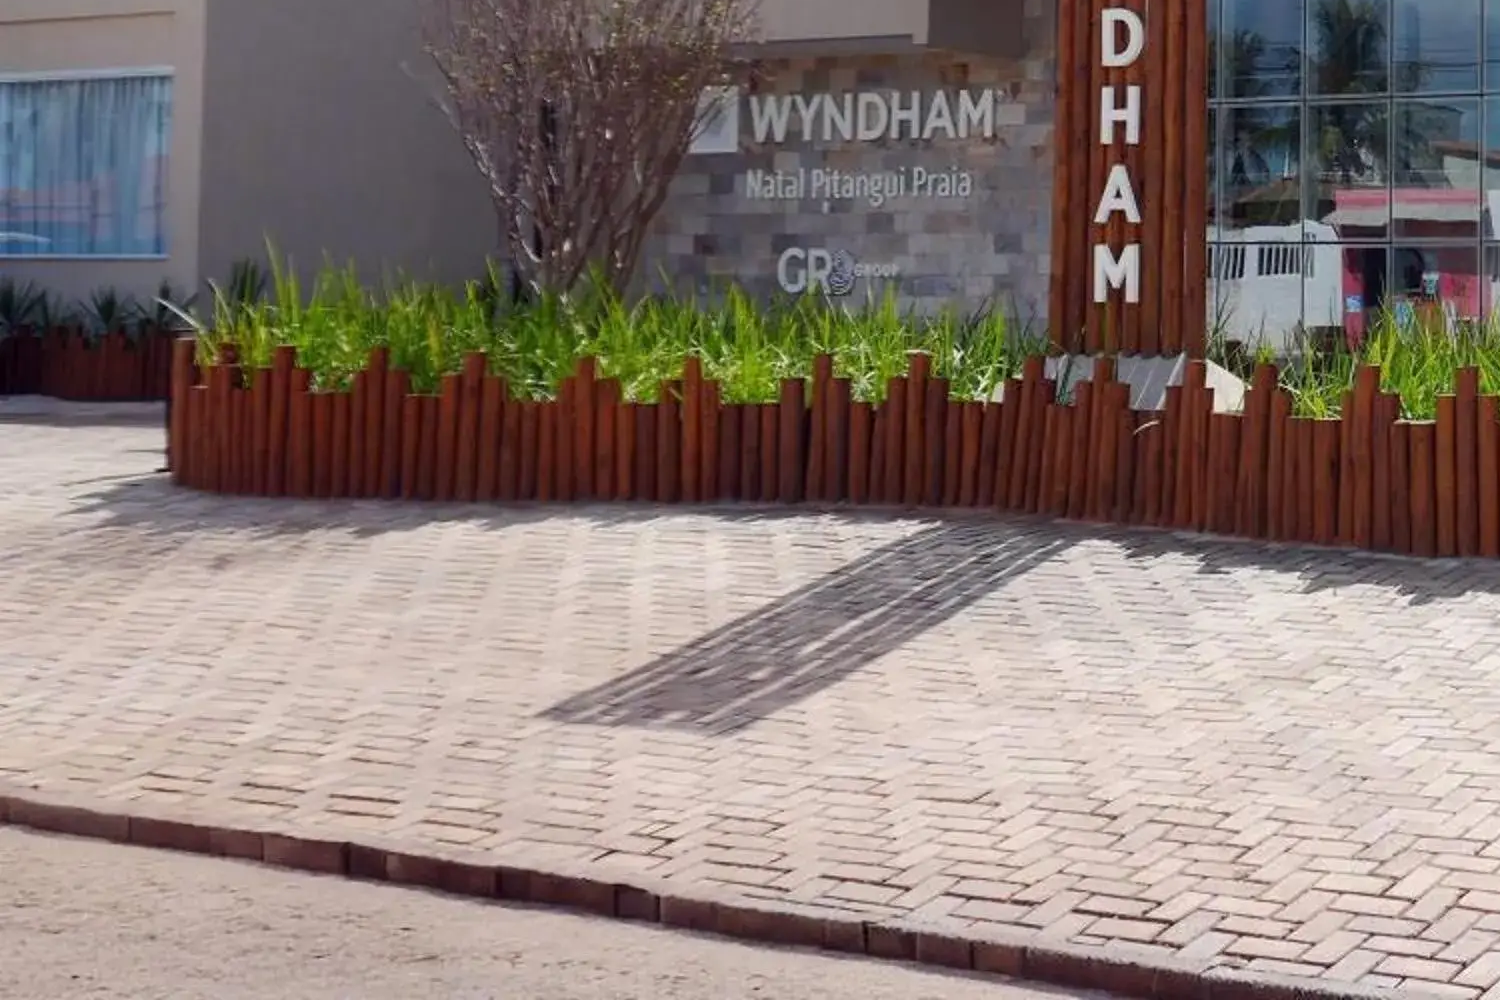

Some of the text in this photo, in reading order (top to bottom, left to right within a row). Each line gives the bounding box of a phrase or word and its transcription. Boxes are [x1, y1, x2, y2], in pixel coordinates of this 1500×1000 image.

[750, 89, 993, 143] WYNDHAM
[746, 165, 972, 207] Natal Pitangui Praia
